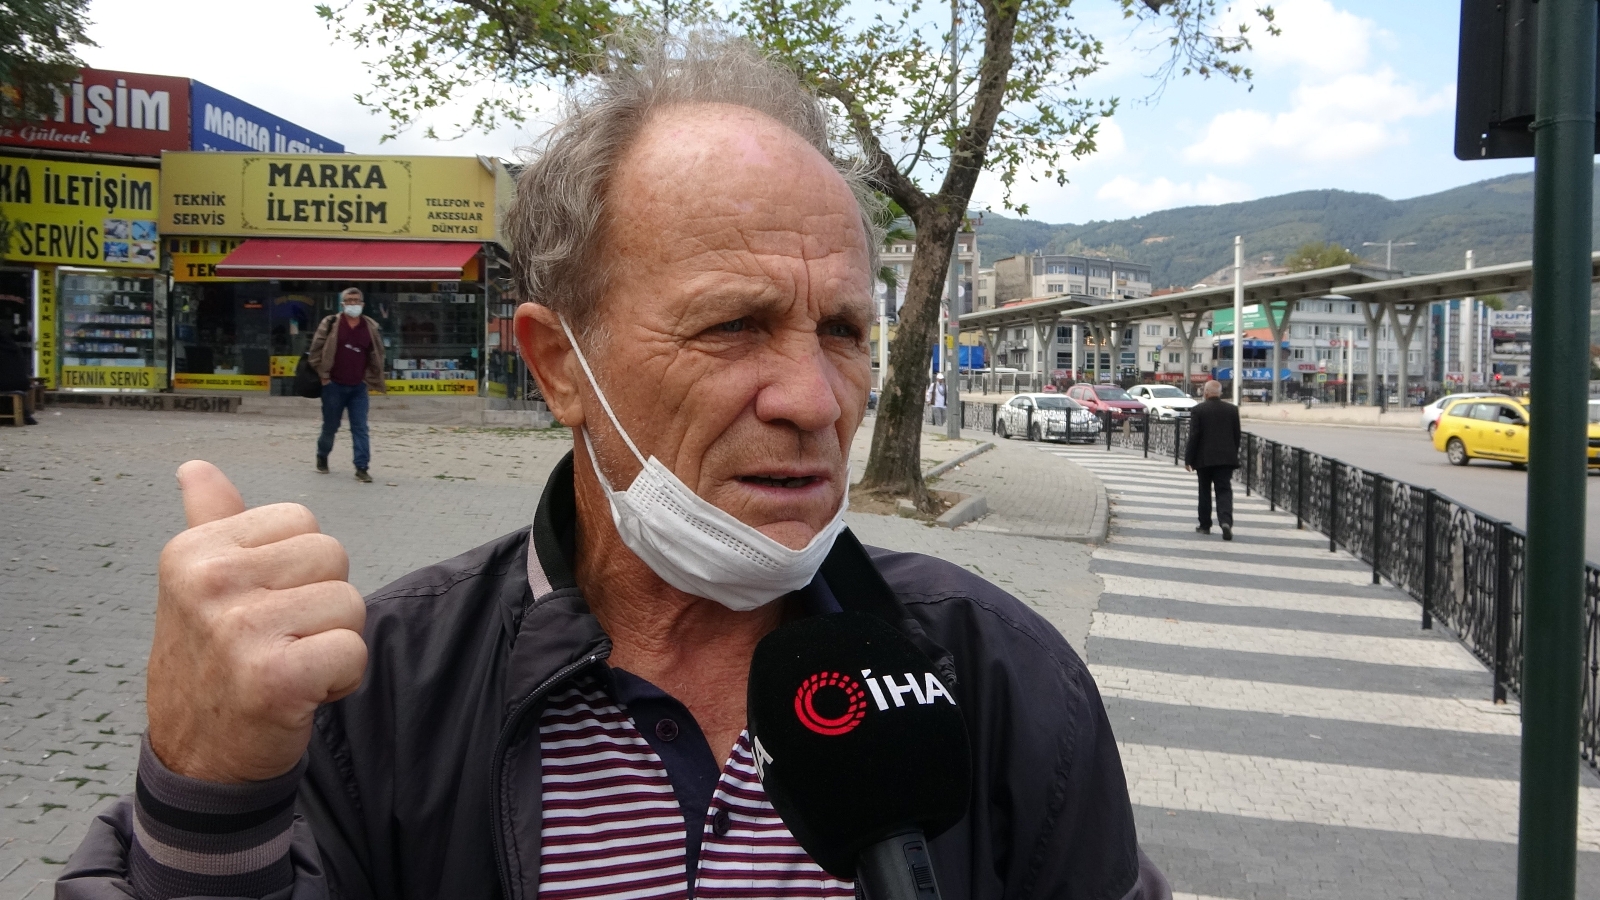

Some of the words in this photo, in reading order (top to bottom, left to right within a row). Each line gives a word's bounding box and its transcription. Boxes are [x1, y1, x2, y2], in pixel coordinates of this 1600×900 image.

[20, 125, 91, 144] Gülecek
[204, 103, 270, 152] MARKA
[269, 163, 387, 189] MARKA
[44, 167, 152, 214] İLETİŞİM
[173, 191, 226, 207] TEKNİK
[267, 192, 388, 232] İLETİŞİM
[426, 198, 469, 209] TELEFON
[473, 200, 485, 209] ve
[173, 211, 225, 227] SERVİS
[427, 210, 483, 222] AKSESUAR
[432, 222, 478, 235] DÜNYASI
[20, 220, 99, 260] SERVİS
[1298, 363, 1317, 371] OTEL
[65, 368, 107, 386] TEKNİK
[110, 368, 150, 387] SERVİS
[408, 384, 434, 392] MARKA
[861, 669, 956, 711] İHA
